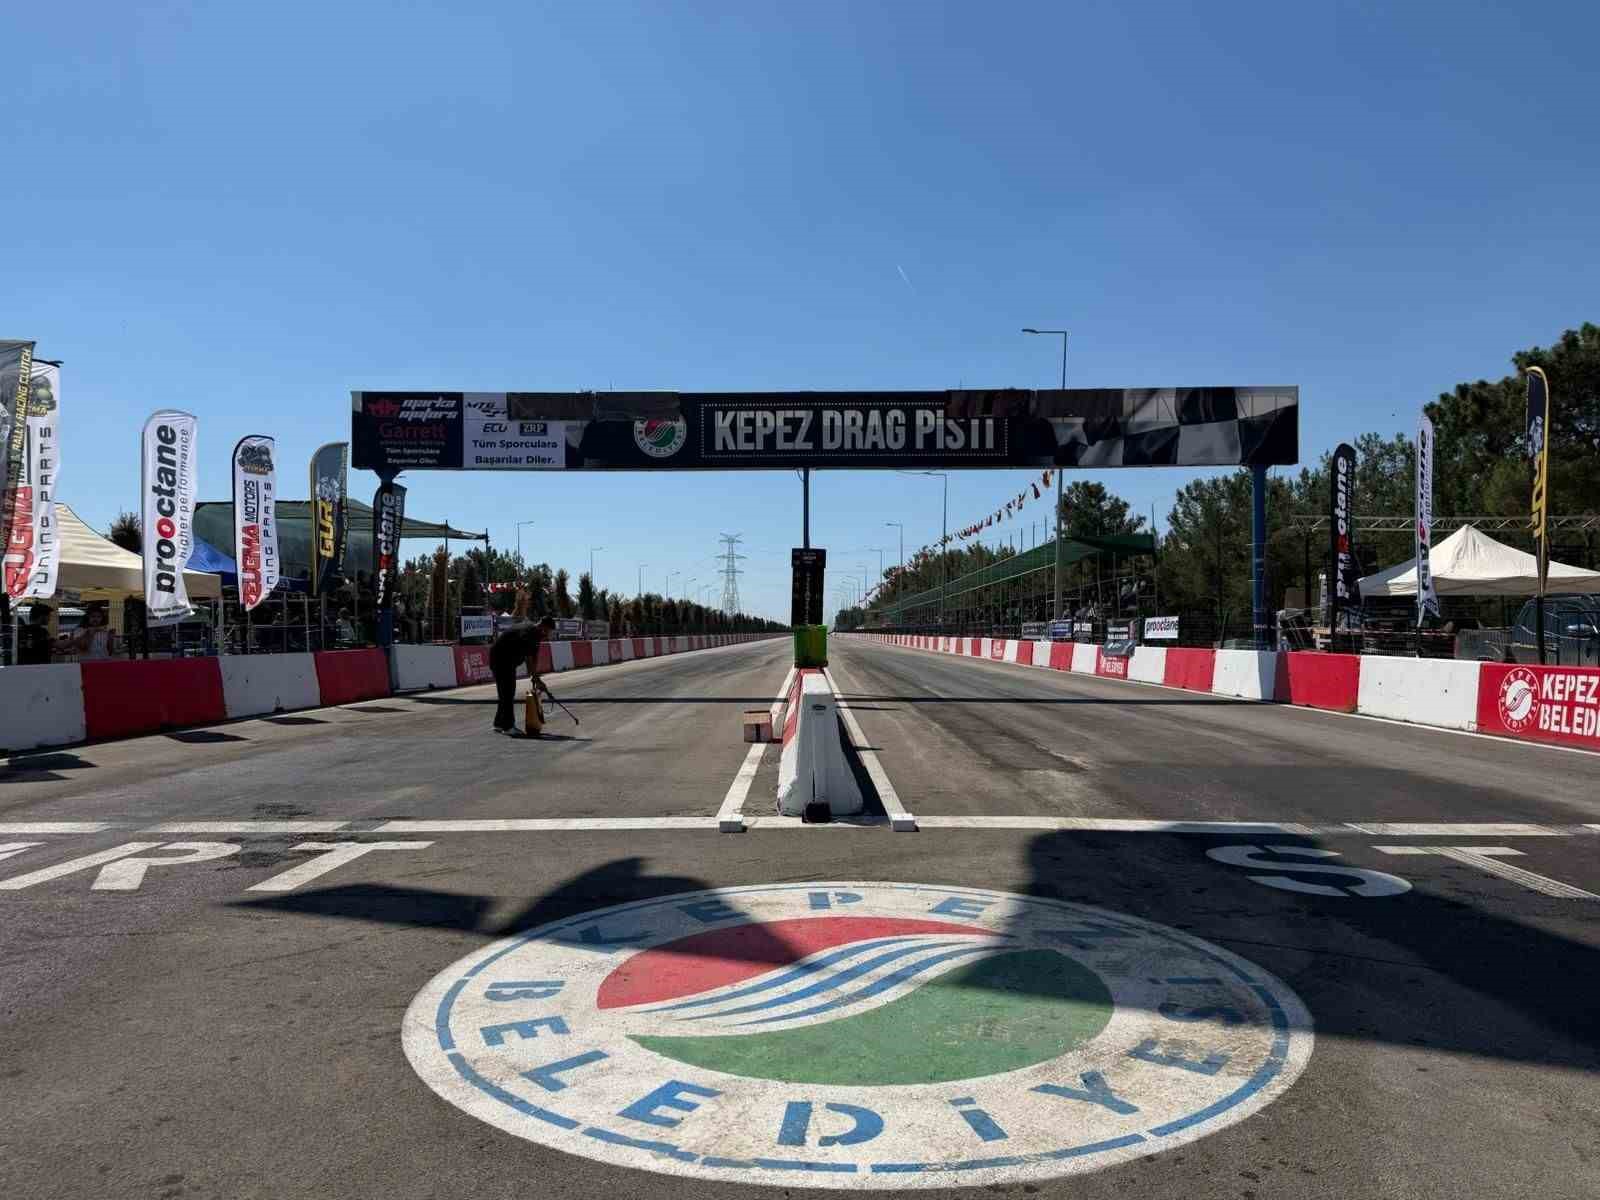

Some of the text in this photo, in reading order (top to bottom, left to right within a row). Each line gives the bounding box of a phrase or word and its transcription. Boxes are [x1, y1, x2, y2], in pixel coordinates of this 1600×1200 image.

[19, 348, 31, 385] CLUTCH
[15, 386, 28, 420] RACING
[472, 440, 559, 452] Tüm Sporculara
[715, 410, 814, 450] KEPEZ
[822, 409, 905, 450] DRAG
[40, 427, 52, 502] PARTS
[178, 428, 191, 513] performance
[151, 424, 177, 594] prooctane
[244, 479, 256, 522] MOTORS
[263, 482, 274, 538] PARTS
[1542, 673, 1600, 705] KEPEZ
